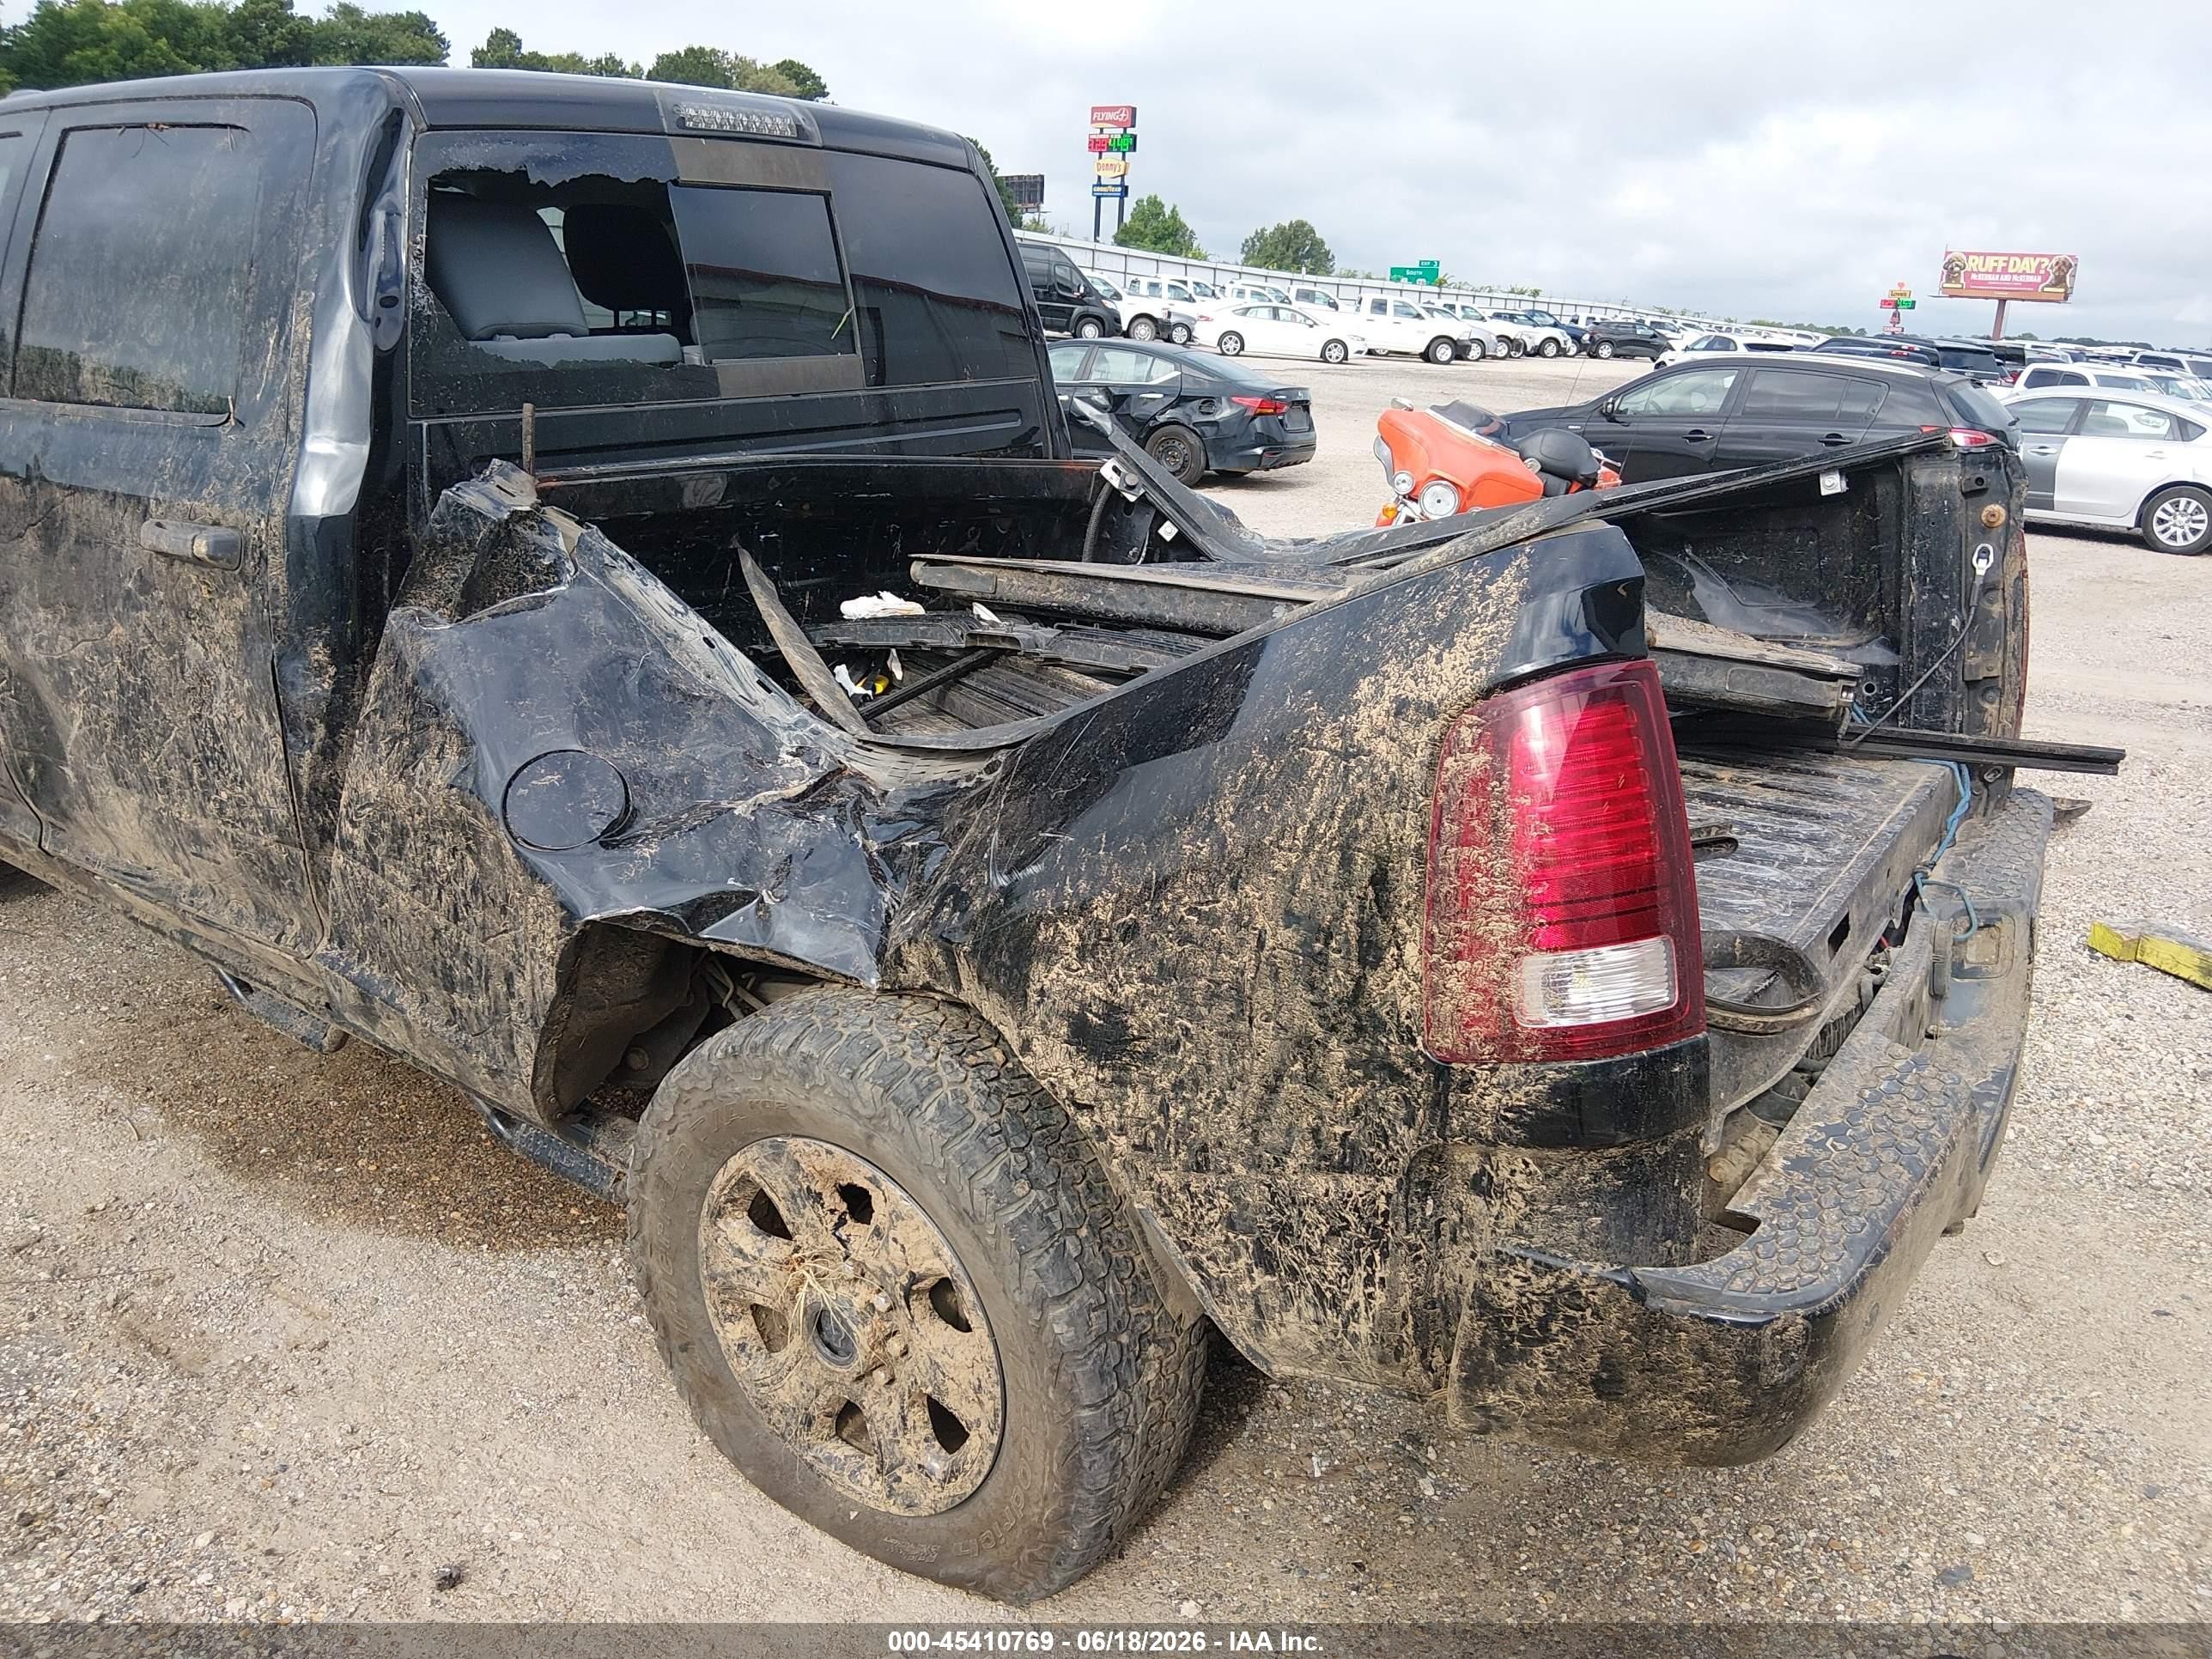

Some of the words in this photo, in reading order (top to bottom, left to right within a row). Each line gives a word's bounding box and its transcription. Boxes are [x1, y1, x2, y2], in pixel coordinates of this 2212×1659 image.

[1092, 111, 1120, 121] FLYING
[1097, 162, 1122, 173] Denny's
[1967, 255, 2008, 273] RUFF
[2008, 257, 2050, 275] DAY?
